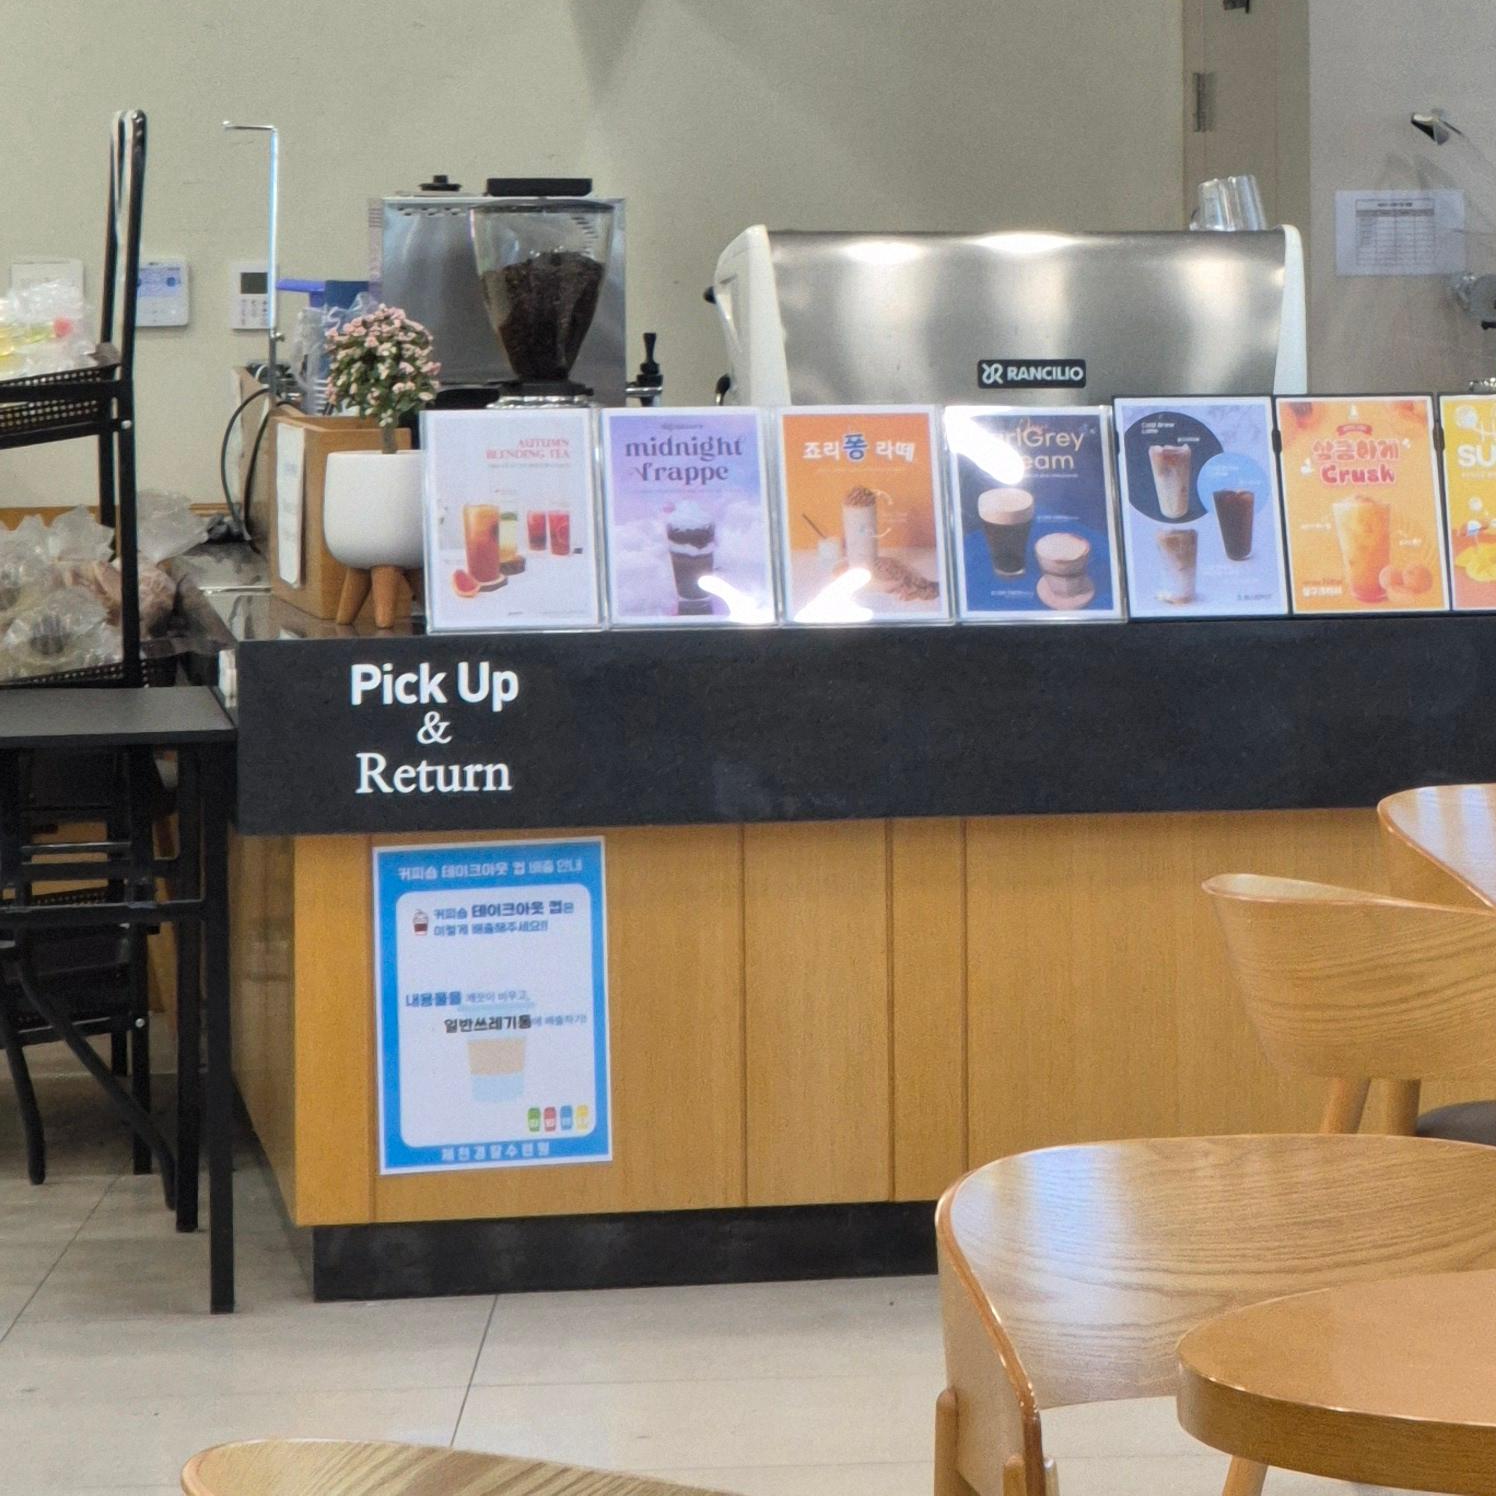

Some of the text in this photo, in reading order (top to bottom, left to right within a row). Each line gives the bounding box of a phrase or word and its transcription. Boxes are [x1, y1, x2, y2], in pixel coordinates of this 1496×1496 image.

[1006, 365, 1085, 382] RANCILIO
[517, 438, 570, 448] AUTUMN
[625, 434, 746, 462] midnight
[875, 441, 916, 463] 라떼
[630, 461, 729, 485] frappe
[1320, 463, 1396, 485] Crush
[351, 660, 519, 712] Pick Up
[416, 710, 453, 745] &
[355, 752, 513, 794] Return
[398, 865, 437, 881] 커피숍
[441, 860, 508, 880] 테이크아웃
[512, 860, 526, 876] 컵
[433, 900, 575, 920] 커피숍 테이크아웃 컵은
[433, 923, 470, 937] 이렇게
[406, 990, 462, 1007] 내용물을
